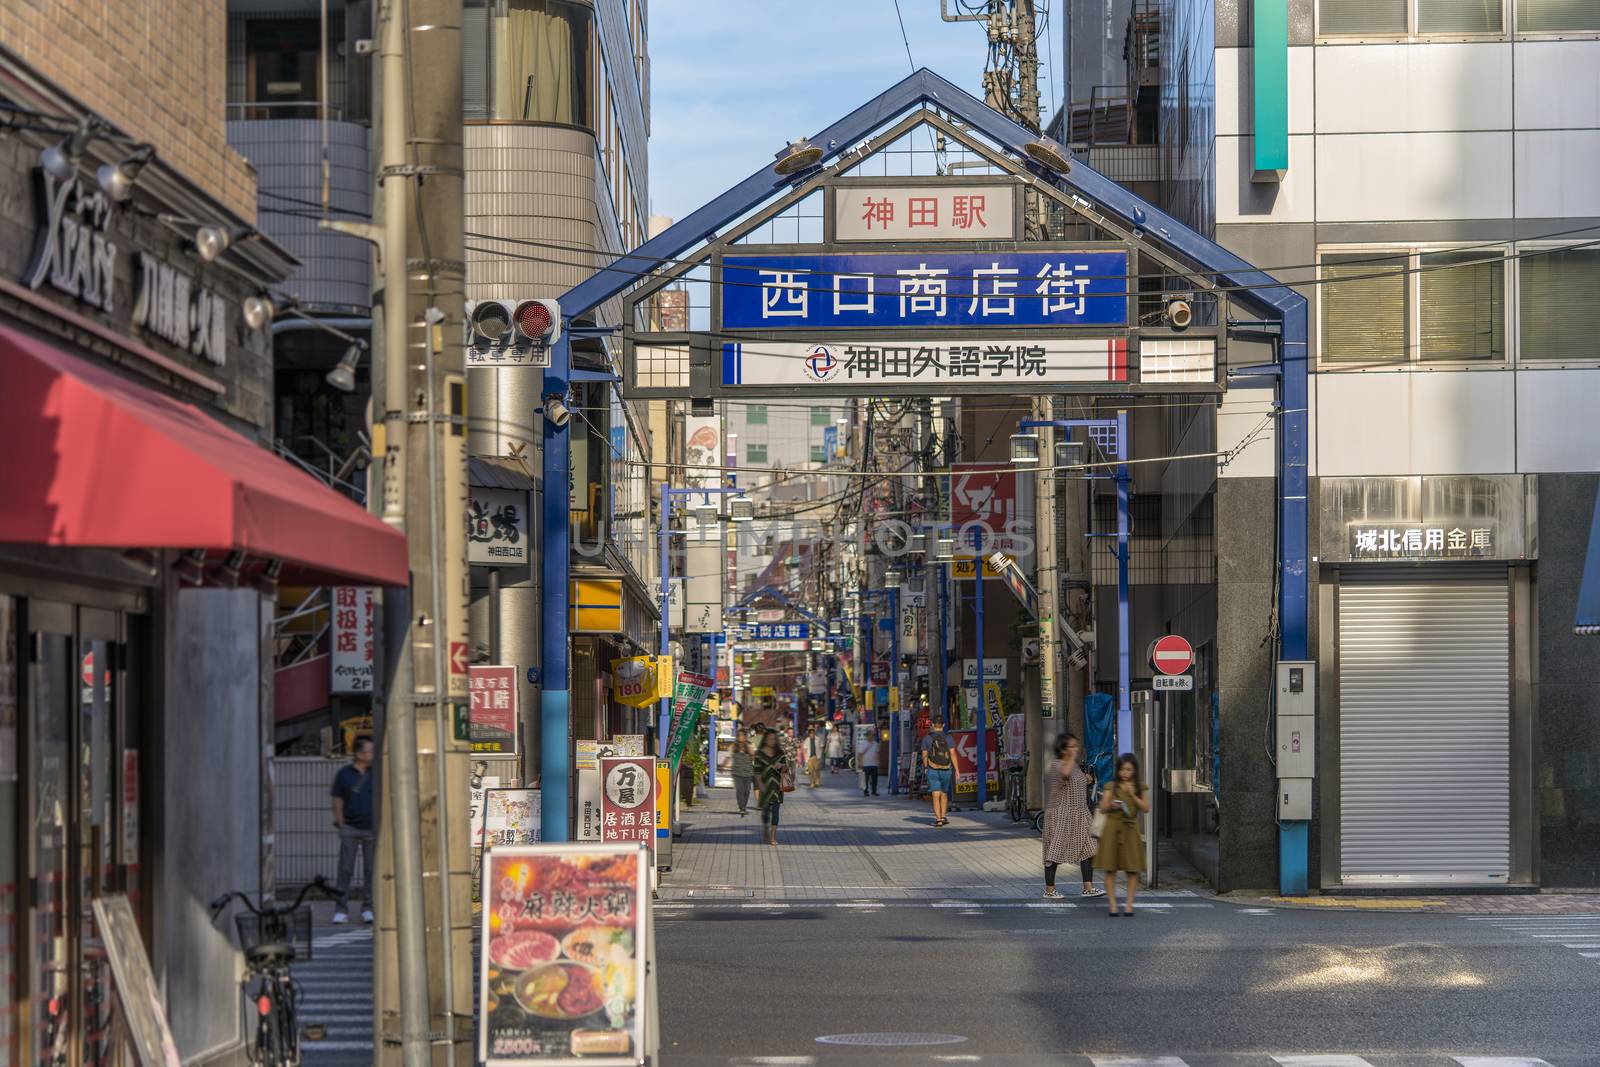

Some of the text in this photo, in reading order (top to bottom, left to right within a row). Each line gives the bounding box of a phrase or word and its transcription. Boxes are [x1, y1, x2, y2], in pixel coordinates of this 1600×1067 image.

[862, 194, 988, 231] 神田駅
[758, 262, 1091, 319] 西口商店街
[843, 345, 1047, 379] 神田外語学院
[488, 546, 523, 557] 神田西口店
[1355, 527, 1492, 551] 城北信用金庫
[351, 677, 371, 690] 2F
[1156, 679, 1189, 688] 自転車を除く
[616, 766, 637, 804] 万屋
[583, 800, 592, 837] 神田西口店
[604, 811, 653, 827] 居酒屋
[606, 828, 651, 841] 地下1階
[520, 892, 631, 922] 麻辣火鍋
